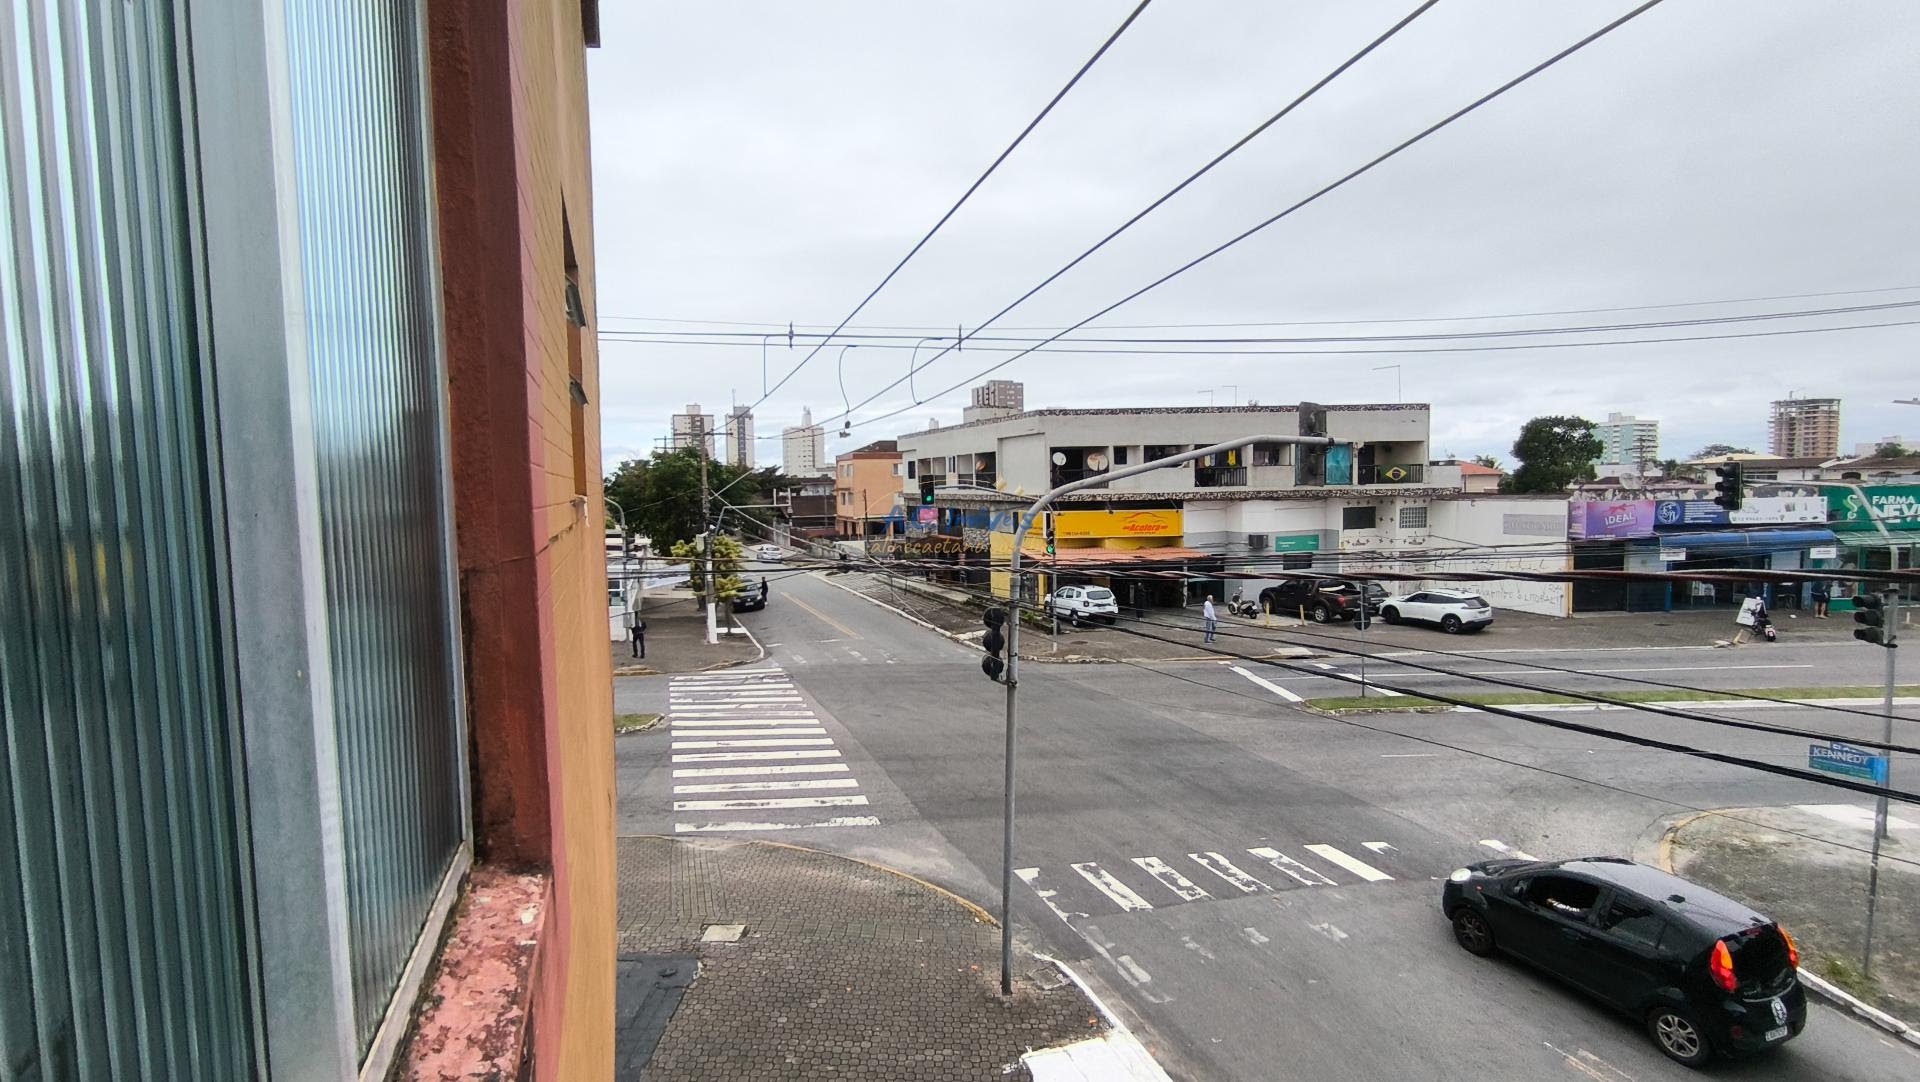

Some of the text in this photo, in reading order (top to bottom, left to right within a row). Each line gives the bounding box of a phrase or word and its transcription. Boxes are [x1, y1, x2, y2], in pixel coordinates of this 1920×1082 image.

[1872, 495, 1916, 505] FARMA
[1605, 512, 1635, 526] IDEAL
[1813, 747, 1868, 764] KENNEDY
